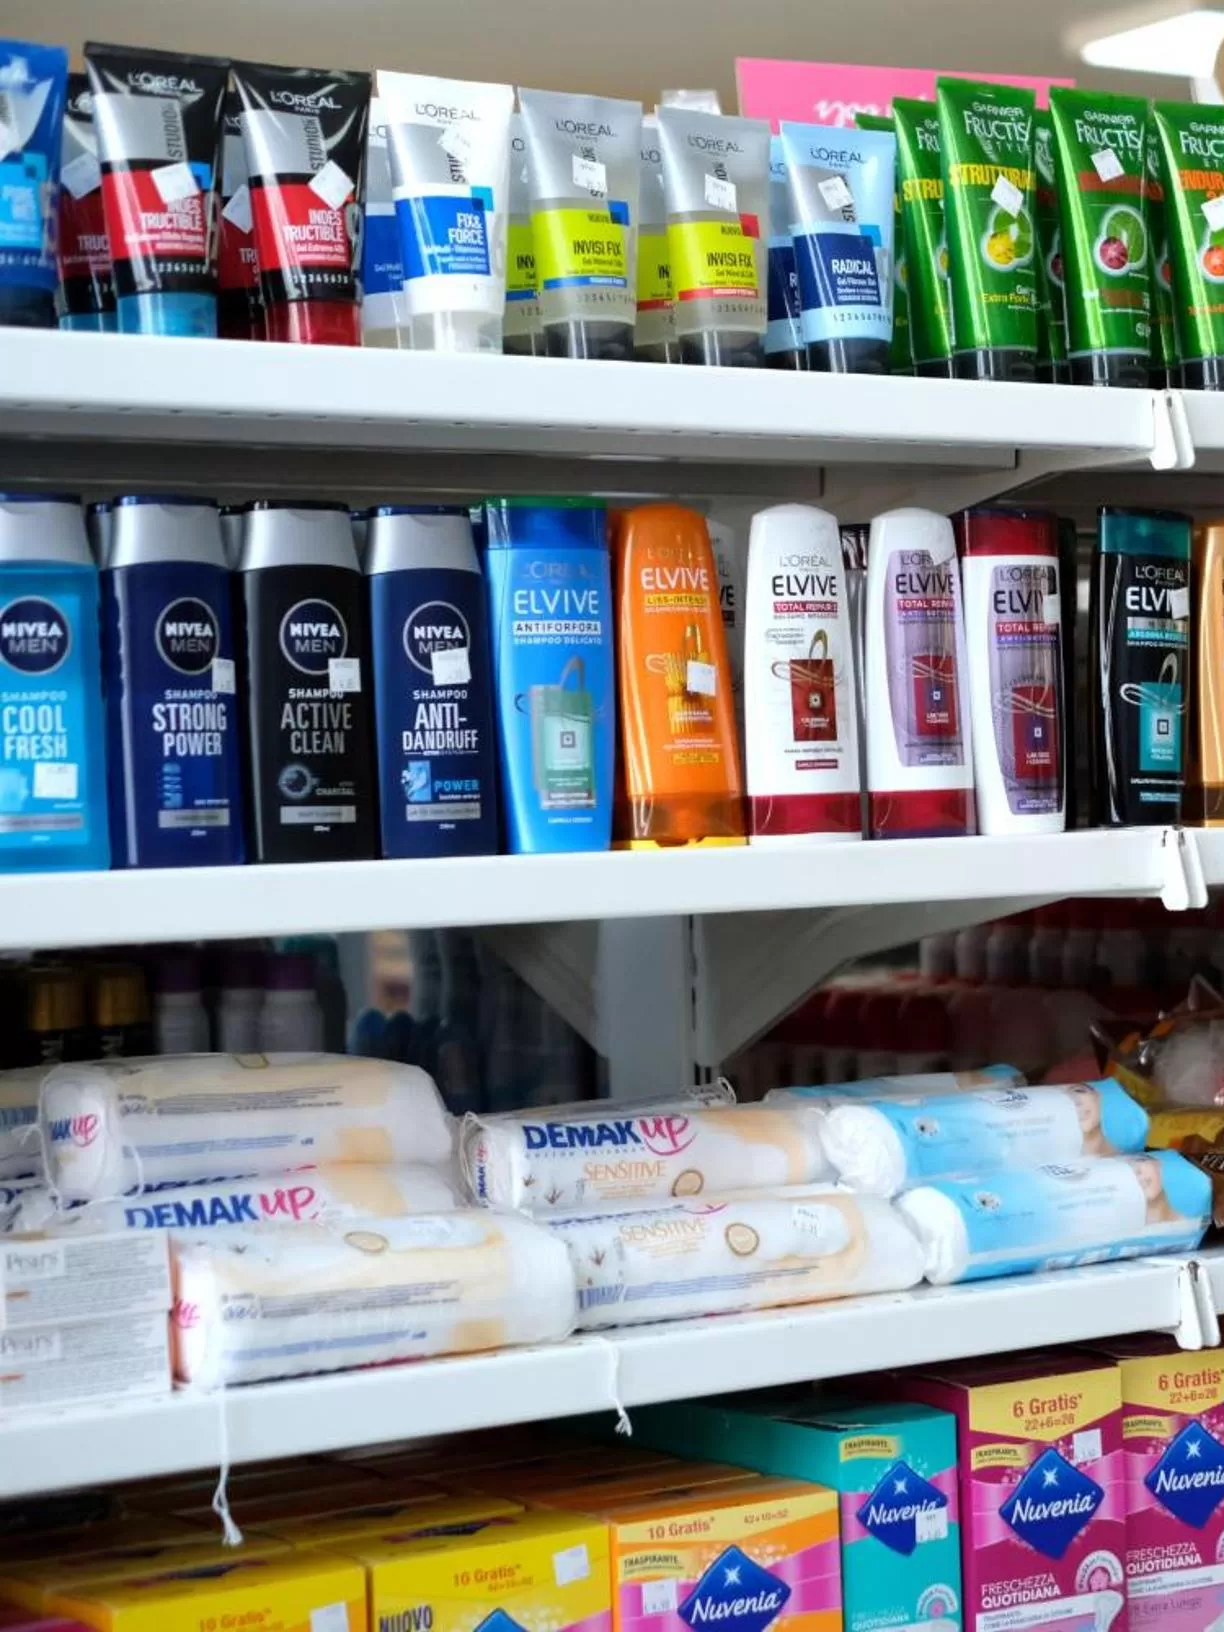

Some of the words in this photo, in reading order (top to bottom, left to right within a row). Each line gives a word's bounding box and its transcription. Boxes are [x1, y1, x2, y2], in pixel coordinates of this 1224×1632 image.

[972, 102, 1024, 117] GARNIER
[1084, 110, 1136, 125] GARNIER
[964, 111, 1030, 142] FRUCTIS
[1075, 119, 1142, 149] FRUCTIS
[448, 228, 484, 245] FORCE
[831, 258, 874, 276] RADICAL
[641, 567, 710, 591] ELVIVE
[772, 574, 837, 597] ELVIVE
[896, 573, 955, 595] ELVIVE
[513, 589, 600, 615] ELVIVE
[775, 602, 804, 612] TOTAL
[899, 600, 928, 609] TOTAL
[993, 590, 1044, 614] ELVI
[1126, 586, 1171, 613] ELVI
[2, 622, 63, 638] NIVEA
[165, 622, 214, 638] NIVEA
[290, 622, 341, 638] NIVEA
[414, 626, 464, 640] NIVEA
[515, 621, 600, 635] ANTIFORFORA
[998, 623, 1031, 633] TOTAL
[9, 638, 58, 654] MEN
[171, 638, 210, 653] MEN
[295, 638, 336, 653] MEN
[413, 689, 468, 700] SHAMPOO
[3, 704, 67, 734] COOL
[152, 702, 227, 732] STRONG
[281, 702, 353, 731] ACTIVE
[414, 702, 468, 731] ANTI-
[4, 734, 68, 759] FRESH
[163, 732, 222, 756] POWER
[290, 730, 345, 754] CLEAN
[402, 730, 479, 751] DANDRUFF
[434, 779, 480, 793] POWER
[583, 1160, 668, 1181] SENSITIVE
[1157, 1374, 1169, 1391] 6
[1012, 1401, 1023, 1418] 6
[1010, 1492, 1094, 1526] Nuvenia
[648, 1526, 666, 1540] 10
[623, 1554, 680, 1568] TRASPIRANTE
[1126, 1541, 1198, 1562] FRESCHEZZA
[1126, 1553, 1203, 1576] QUOTIDIANA
[981, 1573, 1056, 1597] FRESCHEZZA
[691, 1588, 782, 1625] Nuvenia
[981, 1585, 1062, 1610] QUOTIDIANA
[379, 1604, 434, 1632] NUOVO
